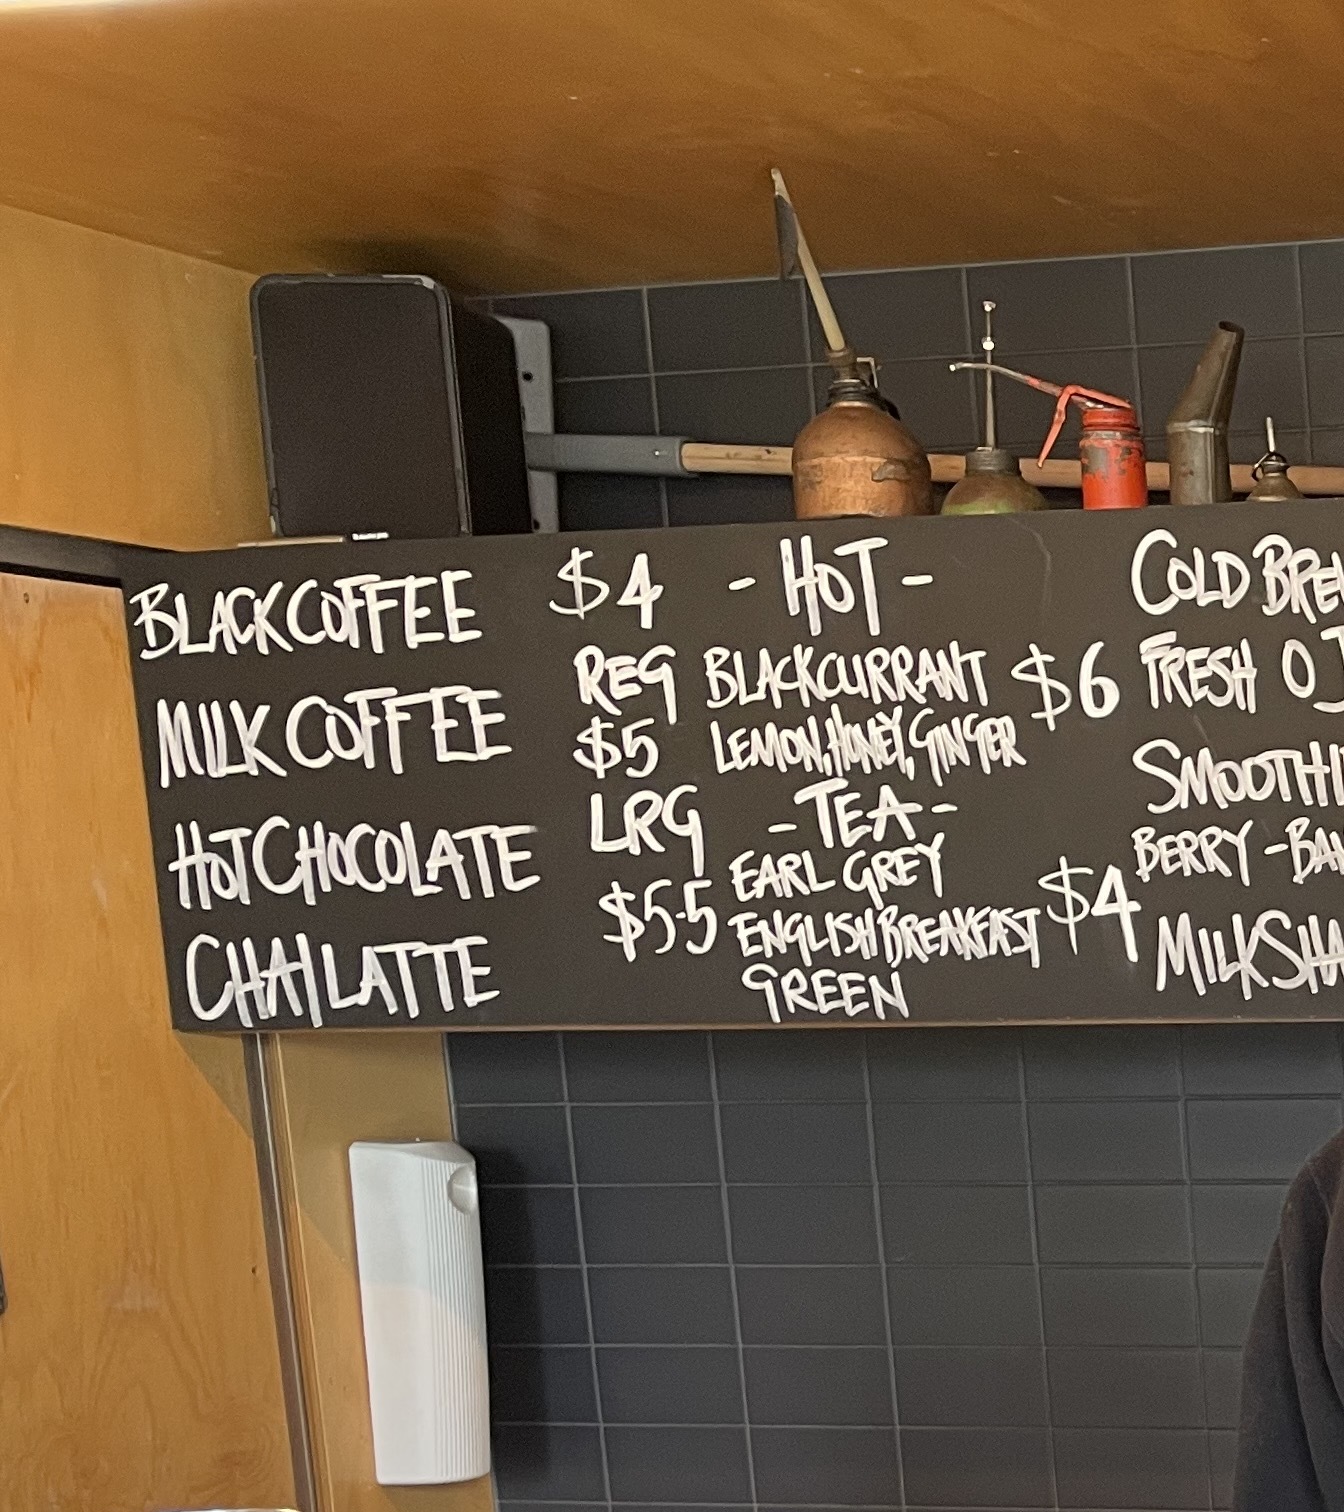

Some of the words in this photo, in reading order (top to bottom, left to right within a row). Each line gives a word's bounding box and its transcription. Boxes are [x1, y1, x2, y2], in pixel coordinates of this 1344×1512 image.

[549, 546, 665, 631] $4
[1130, 527, 1252, 618] COLD
[702, 639, 989, 710] BLACKCURRANT
[1010, 640, 1121, 732] $6
[1138, 630, 1258, 714] FRESH
[156, 698, 289, 789] MILK
[286, 685, 514, 775] COFFEE
[572, 715, 660, 780] $5
[588, 783, 704, 880] LRG
[794, 776, 924, 849] TEA
[1130, 820, 1255, 888] BERRY
[250, 815, 542, 907] CHOCOLATE
[728, 849, 837, 903] EARL
[842, 831, 946, 911] GREY
[1037, 854, 1143, 964] $4
[741, 962, 911, 1025] GREEN
